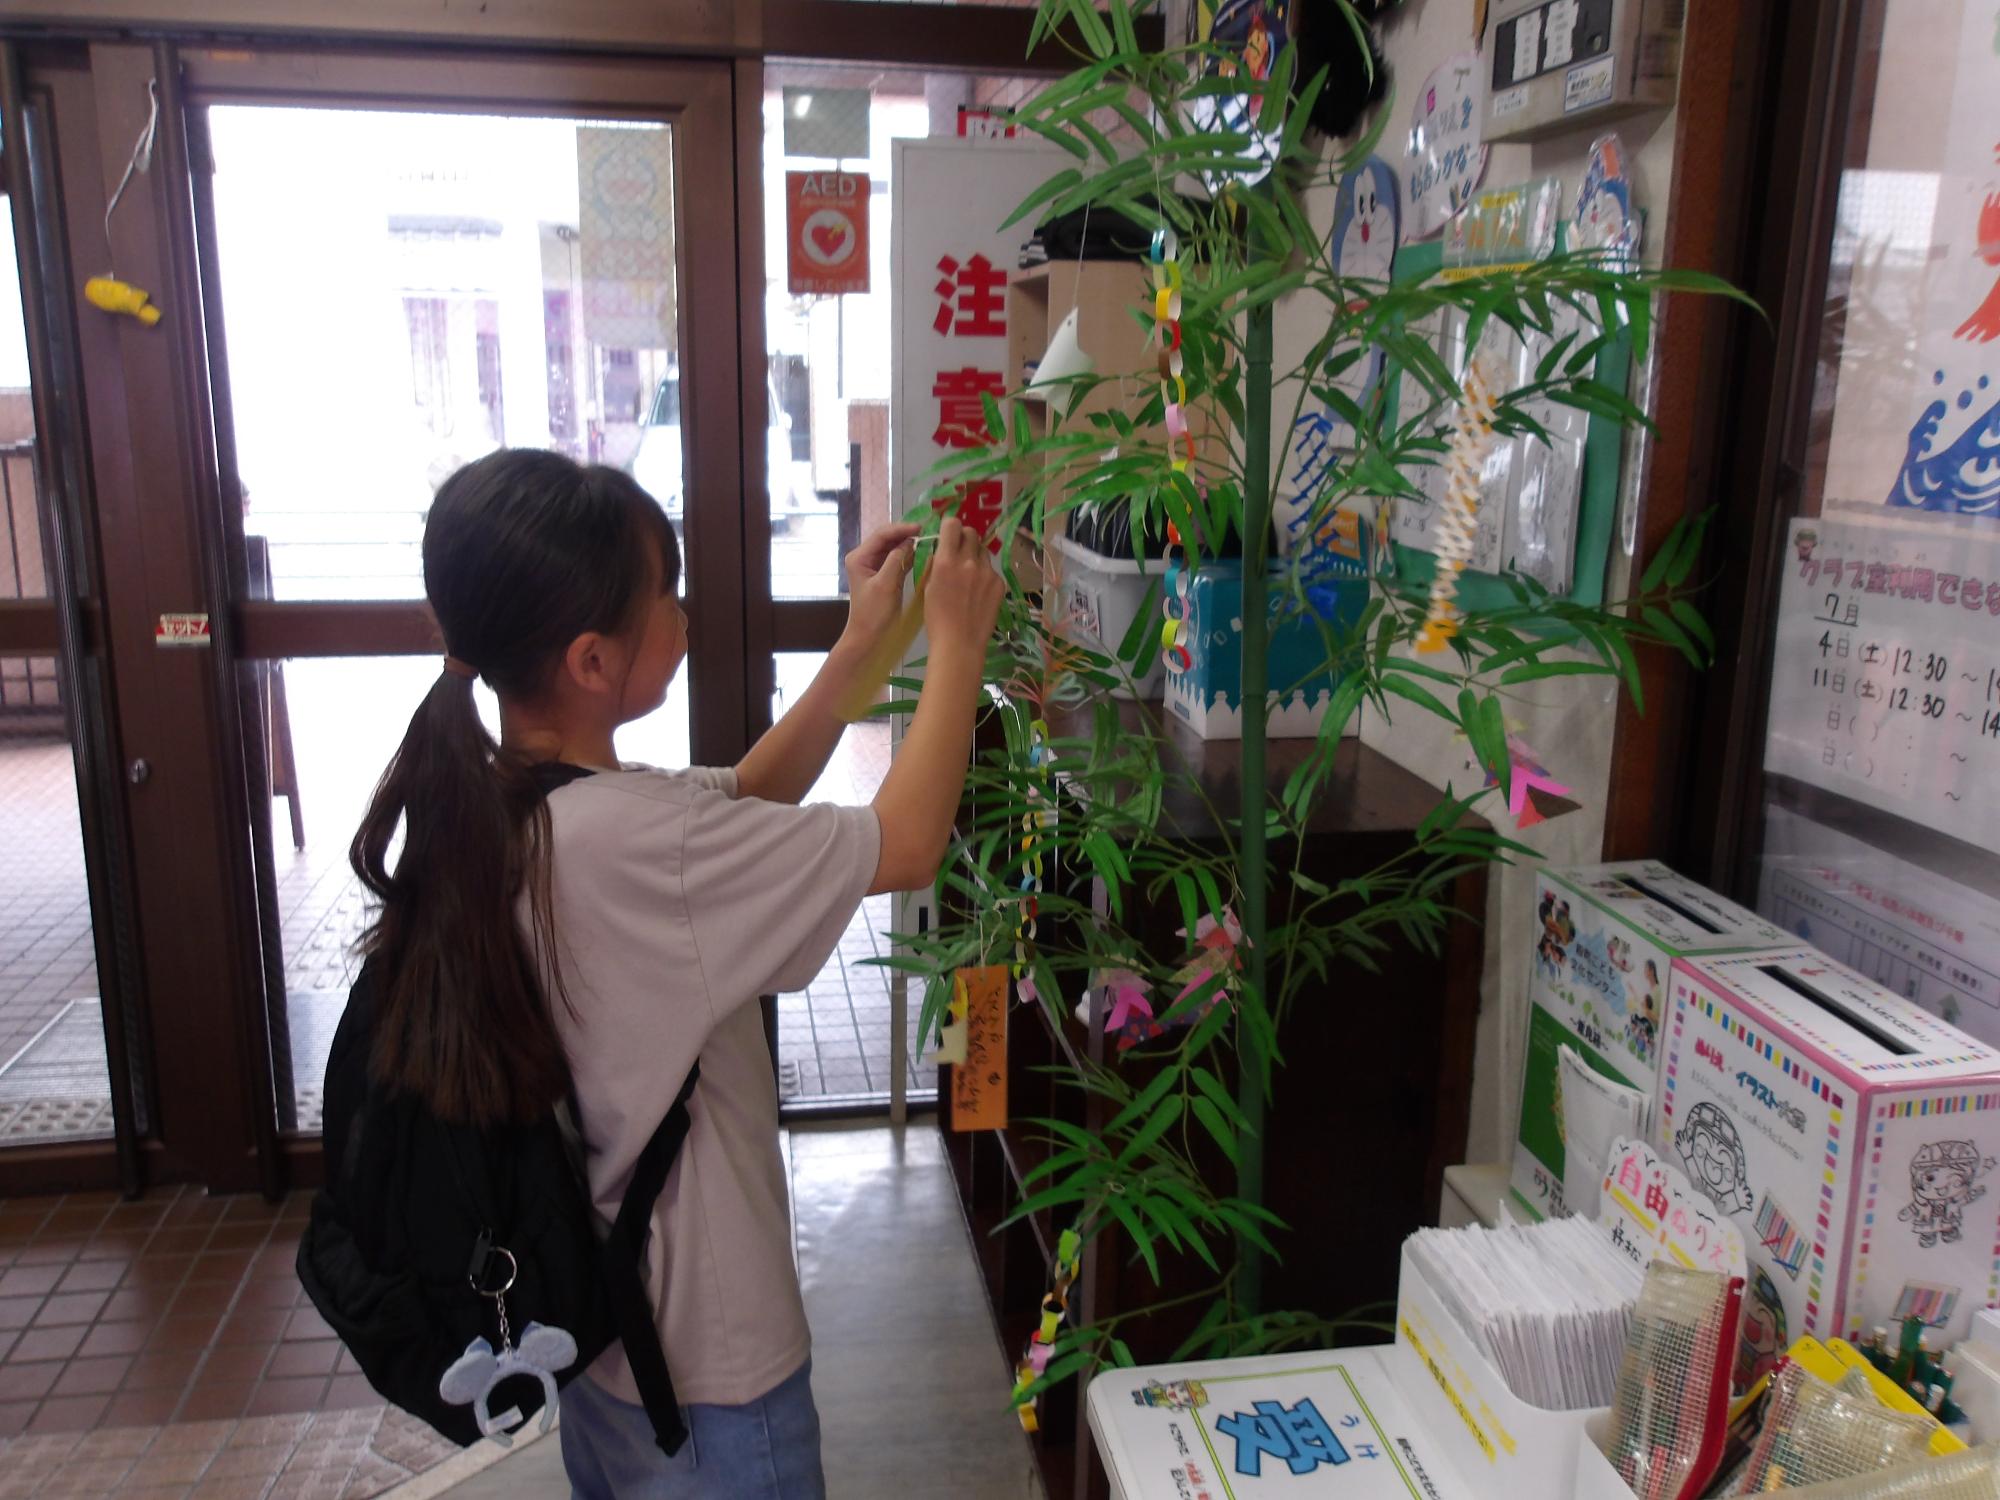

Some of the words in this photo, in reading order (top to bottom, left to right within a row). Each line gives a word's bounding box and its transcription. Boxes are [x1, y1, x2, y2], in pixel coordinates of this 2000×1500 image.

[801, 174, 857, 197] AED
[1825, 592, 1859, 625] 7月
[1215, 1396, 1351, 1477] 受
